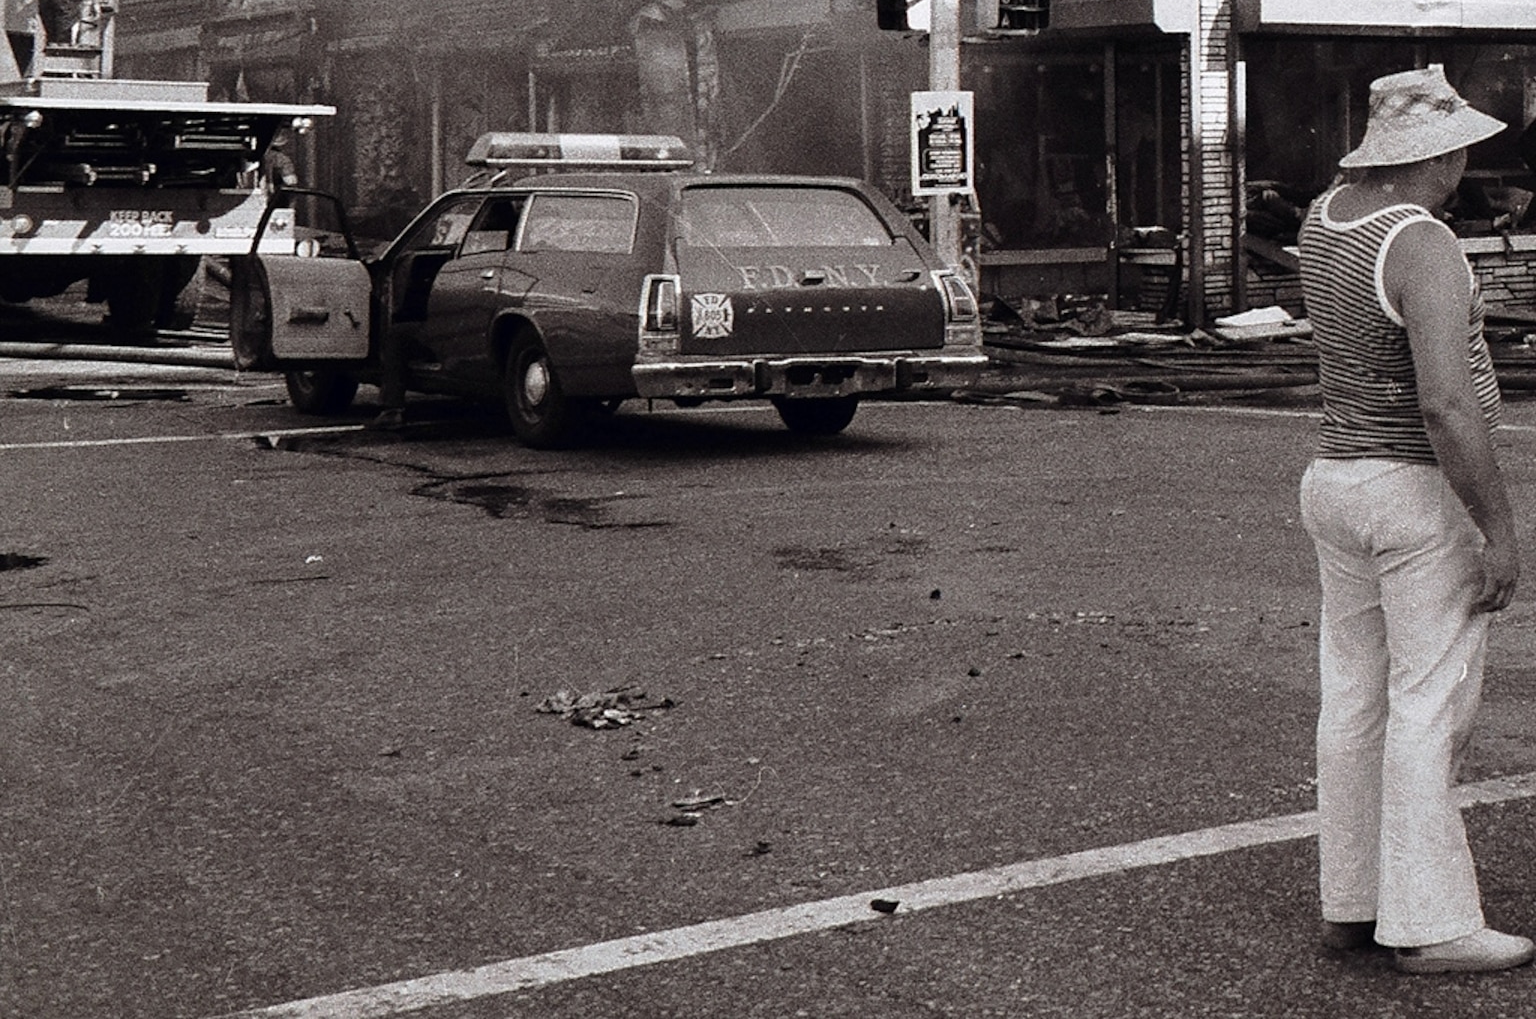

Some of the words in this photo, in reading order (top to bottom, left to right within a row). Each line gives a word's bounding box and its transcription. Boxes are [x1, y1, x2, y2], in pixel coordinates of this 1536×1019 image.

[110, 210, 139, 222] KEEP
[141, 211, 173, 223] BACK
[110, 223, 142, 236] 200
